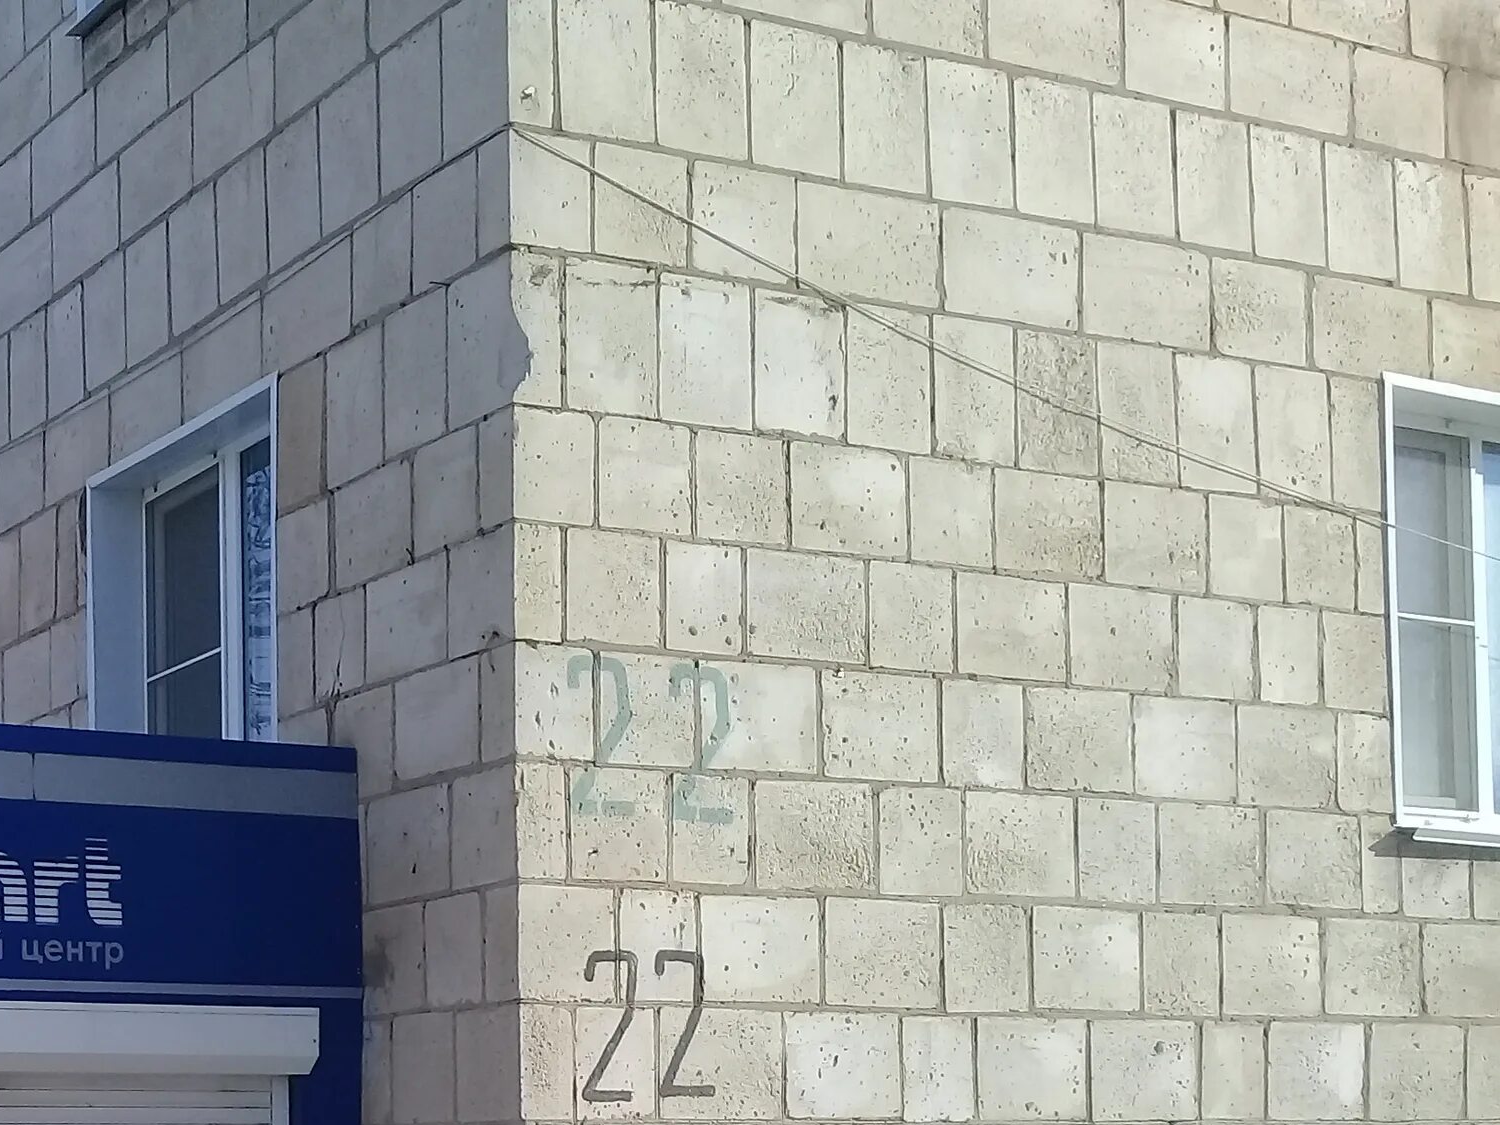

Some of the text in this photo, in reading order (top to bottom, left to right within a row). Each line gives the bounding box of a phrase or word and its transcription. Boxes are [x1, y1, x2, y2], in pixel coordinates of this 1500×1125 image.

[566, 654, 734, 825] 22
[20, 938, 124, 970] центр
[582, 949, 716, 1102] 22
